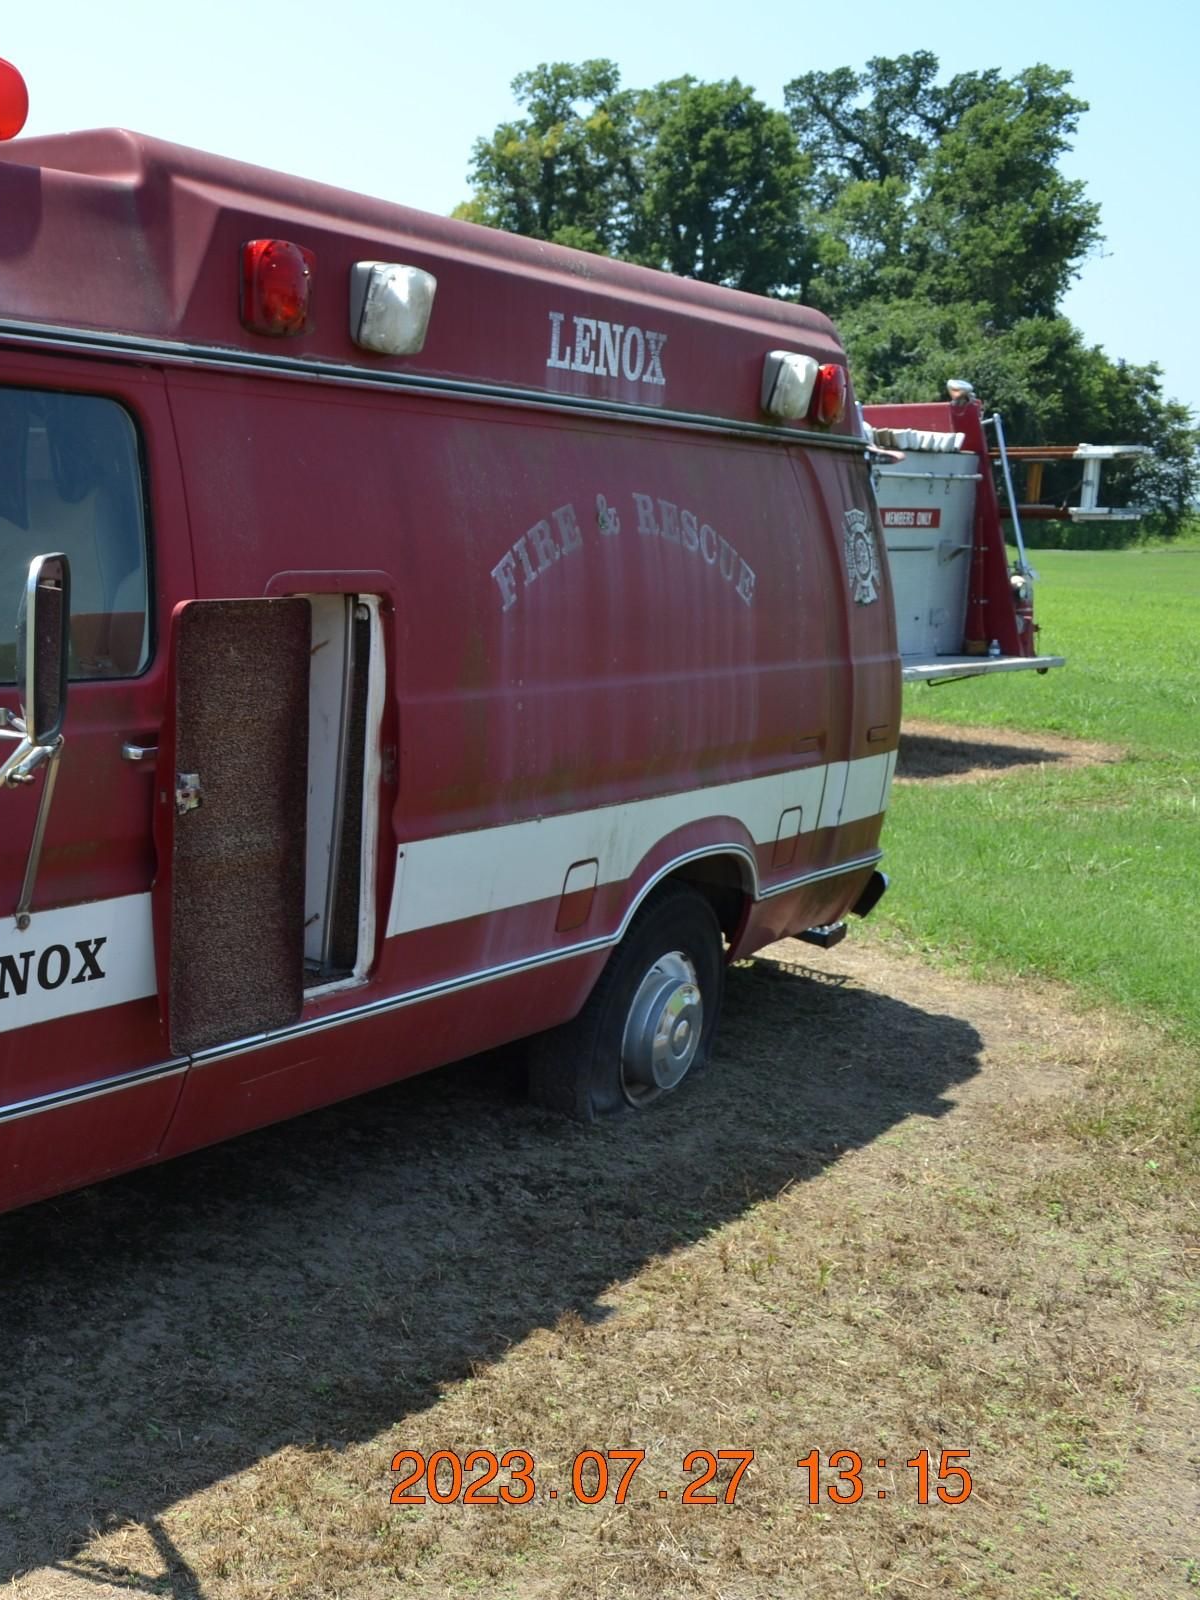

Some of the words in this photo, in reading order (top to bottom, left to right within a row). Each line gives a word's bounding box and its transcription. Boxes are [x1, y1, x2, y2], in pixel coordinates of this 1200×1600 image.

[546, 311, 667, 385] LENOX
[490, 503, 583, 612] FIRE
[596, 493, 620, 536] &
[632, 492, 756, 606] RESCUE
[884, 511, 915, 526] MEMBERS
[916, 511, 933, 526] ONLY
